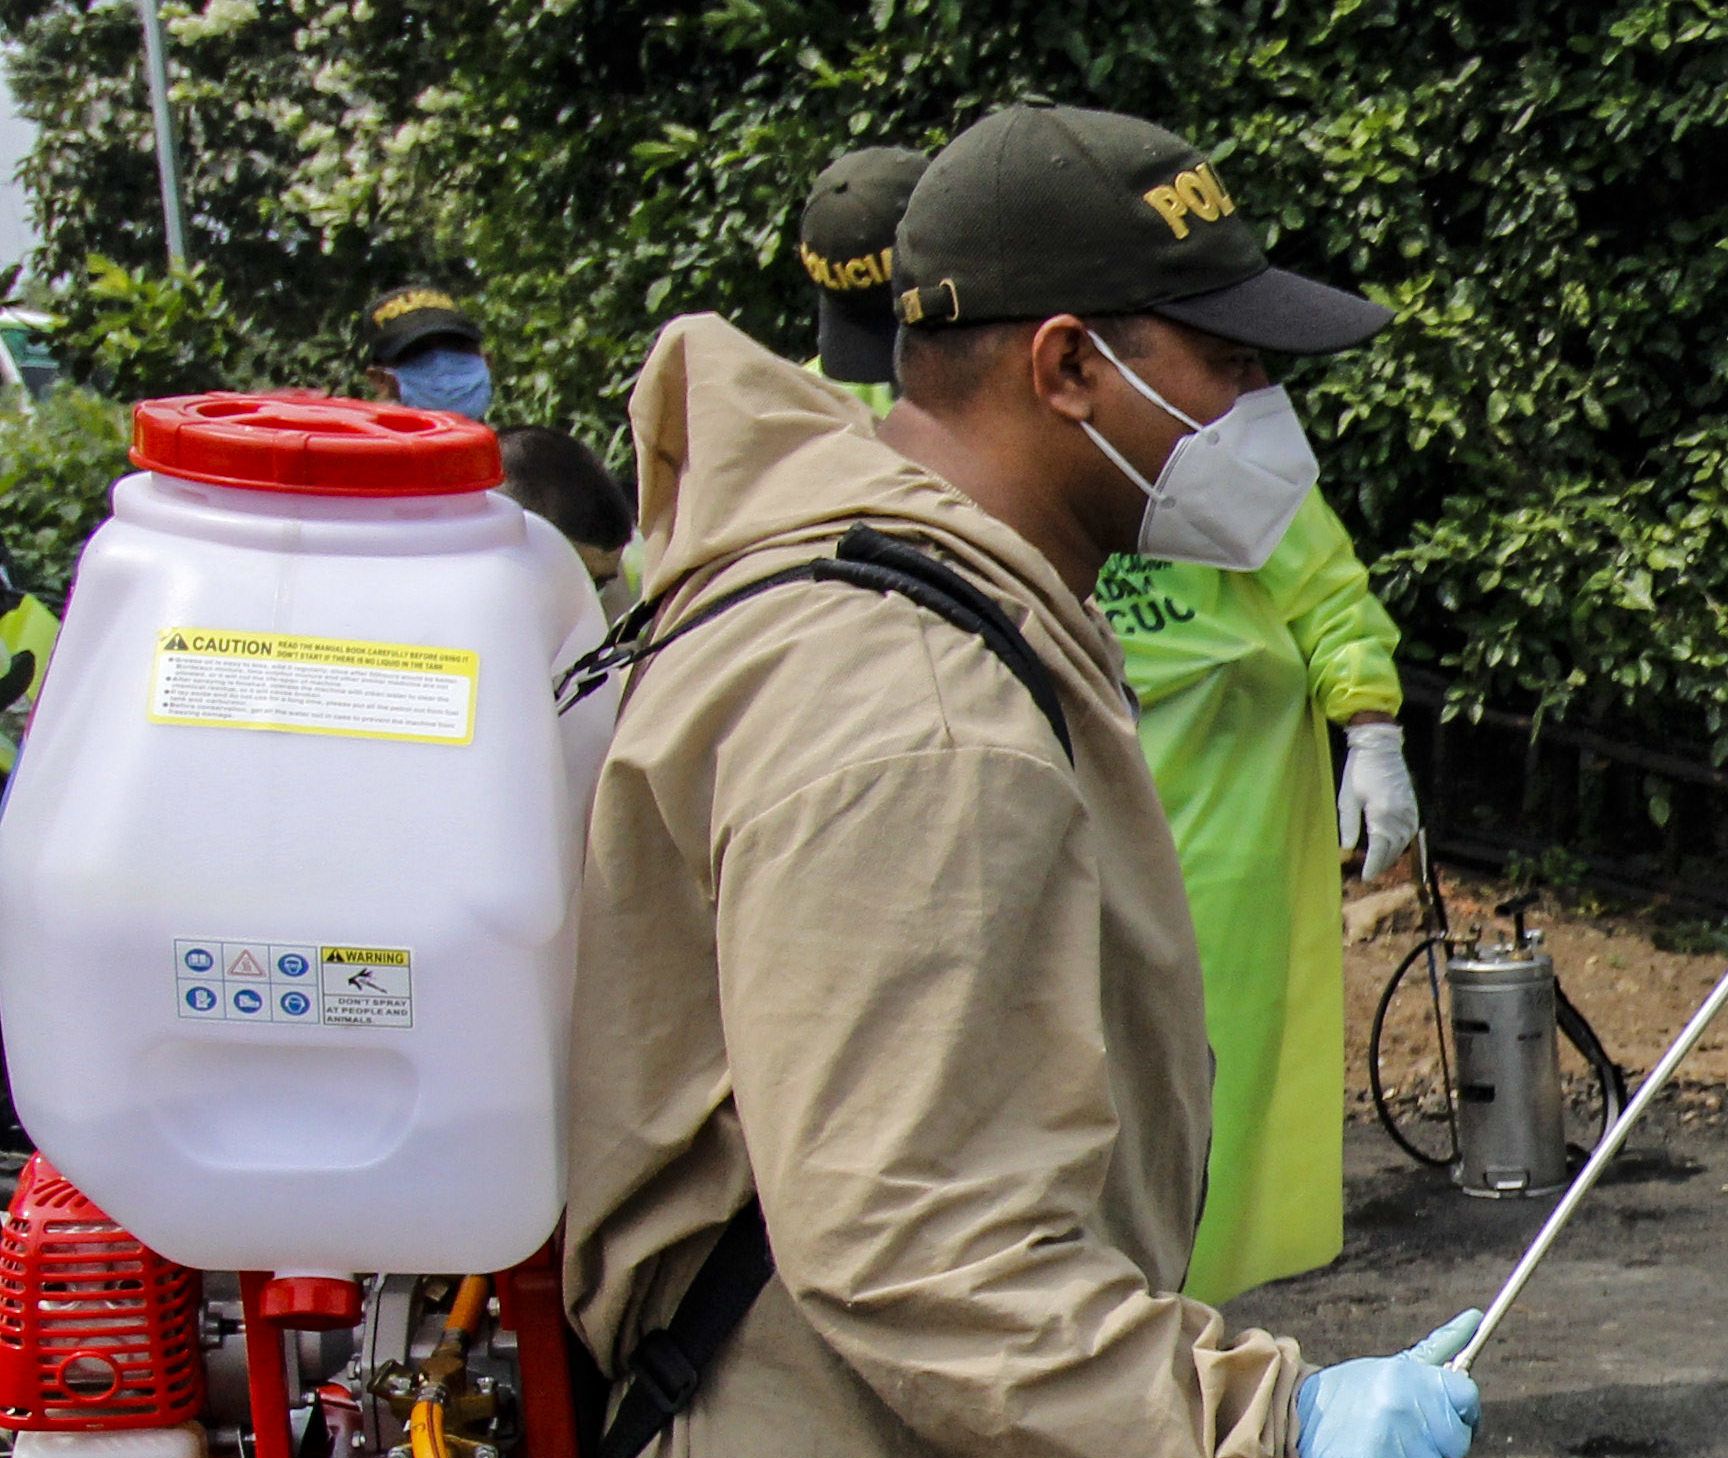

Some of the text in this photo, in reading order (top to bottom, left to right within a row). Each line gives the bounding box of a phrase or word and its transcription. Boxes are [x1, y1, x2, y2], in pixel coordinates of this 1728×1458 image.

[192, 636, 273, 656] CAUTION
[345, 950, 404, 964] WARNING
[338, 997, 407, 1007] DON'T SPRAY
[342, 1007, 383, 1015] PEOPLE
[385, 1008, 408, 1016] AND
